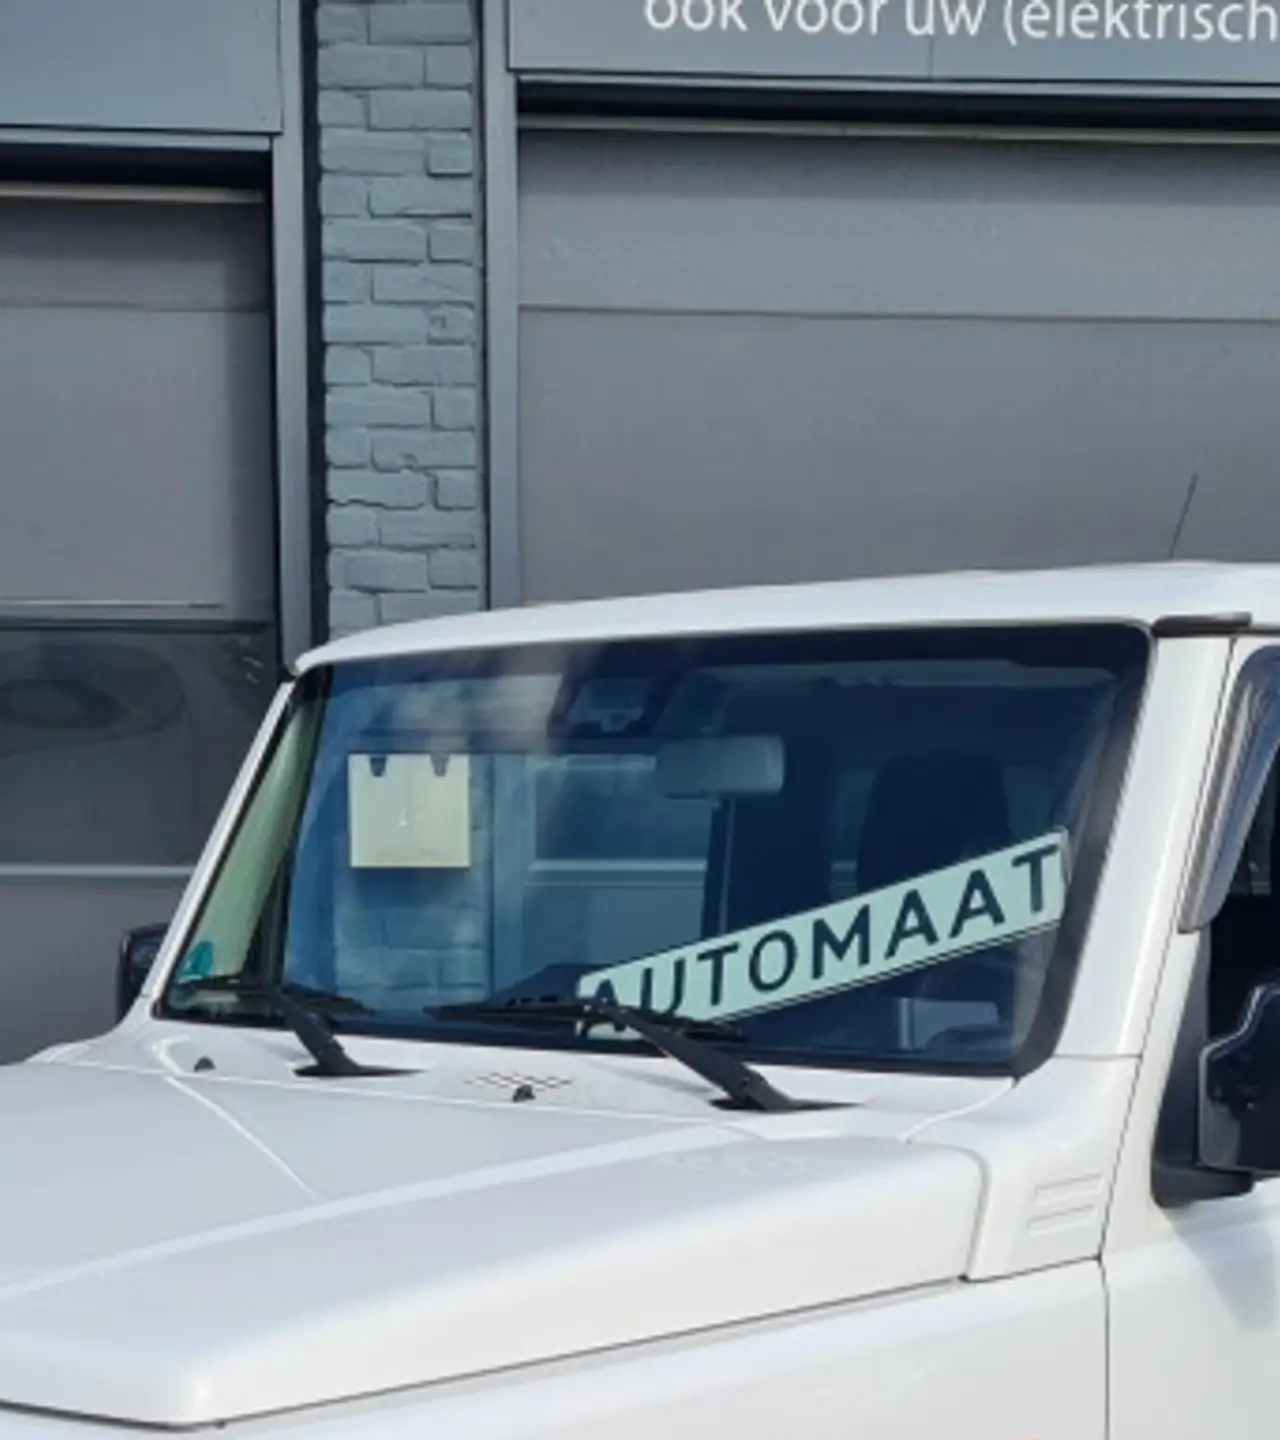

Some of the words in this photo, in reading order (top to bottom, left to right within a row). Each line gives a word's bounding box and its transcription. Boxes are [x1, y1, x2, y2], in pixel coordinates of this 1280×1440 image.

[645, 0, 749, 31] ook
[764, 0, 886, 34] voor
[905, 0, 987, 36] uw
[581, 844, 1060, 1034] AUTOMAAT
